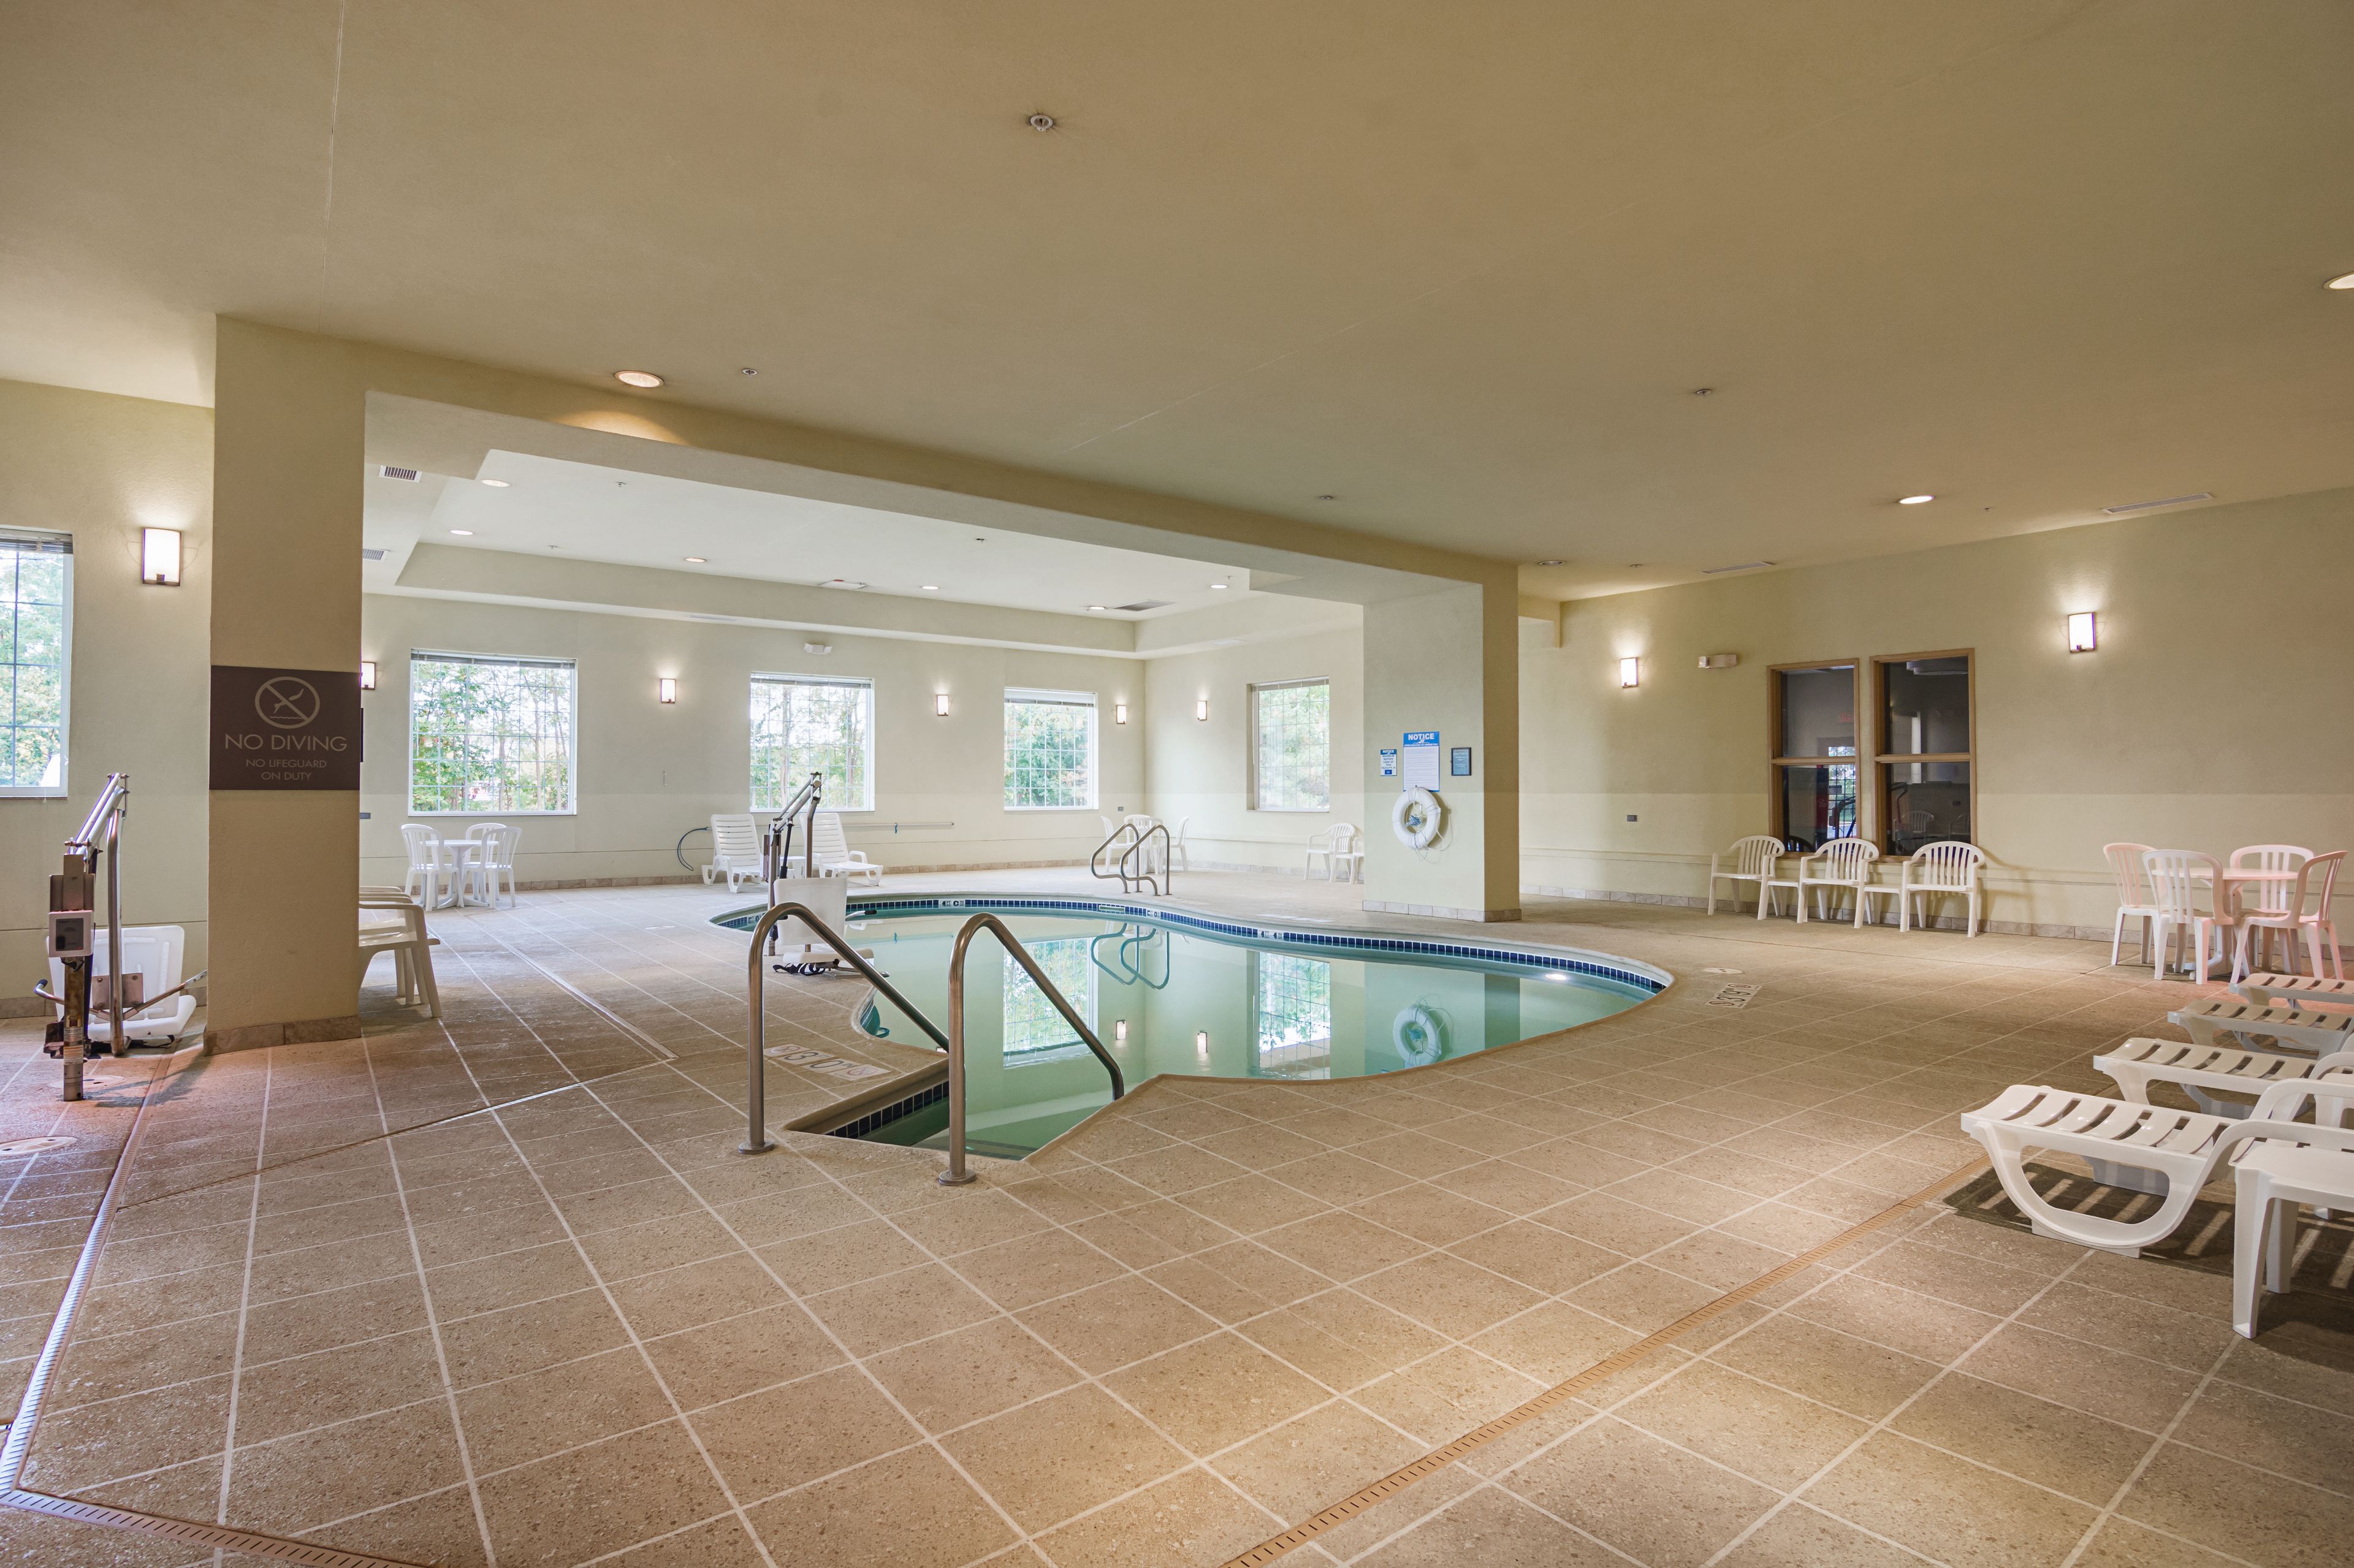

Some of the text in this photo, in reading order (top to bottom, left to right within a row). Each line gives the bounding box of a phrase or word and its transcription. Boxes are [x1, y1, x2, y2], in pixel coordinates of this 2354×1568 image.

[225, 733, 348, 752] NO DIVING
[246, 759, 327, 768] NO LIFEGUARD
[261, 772, 312, 780] ON DUTY
